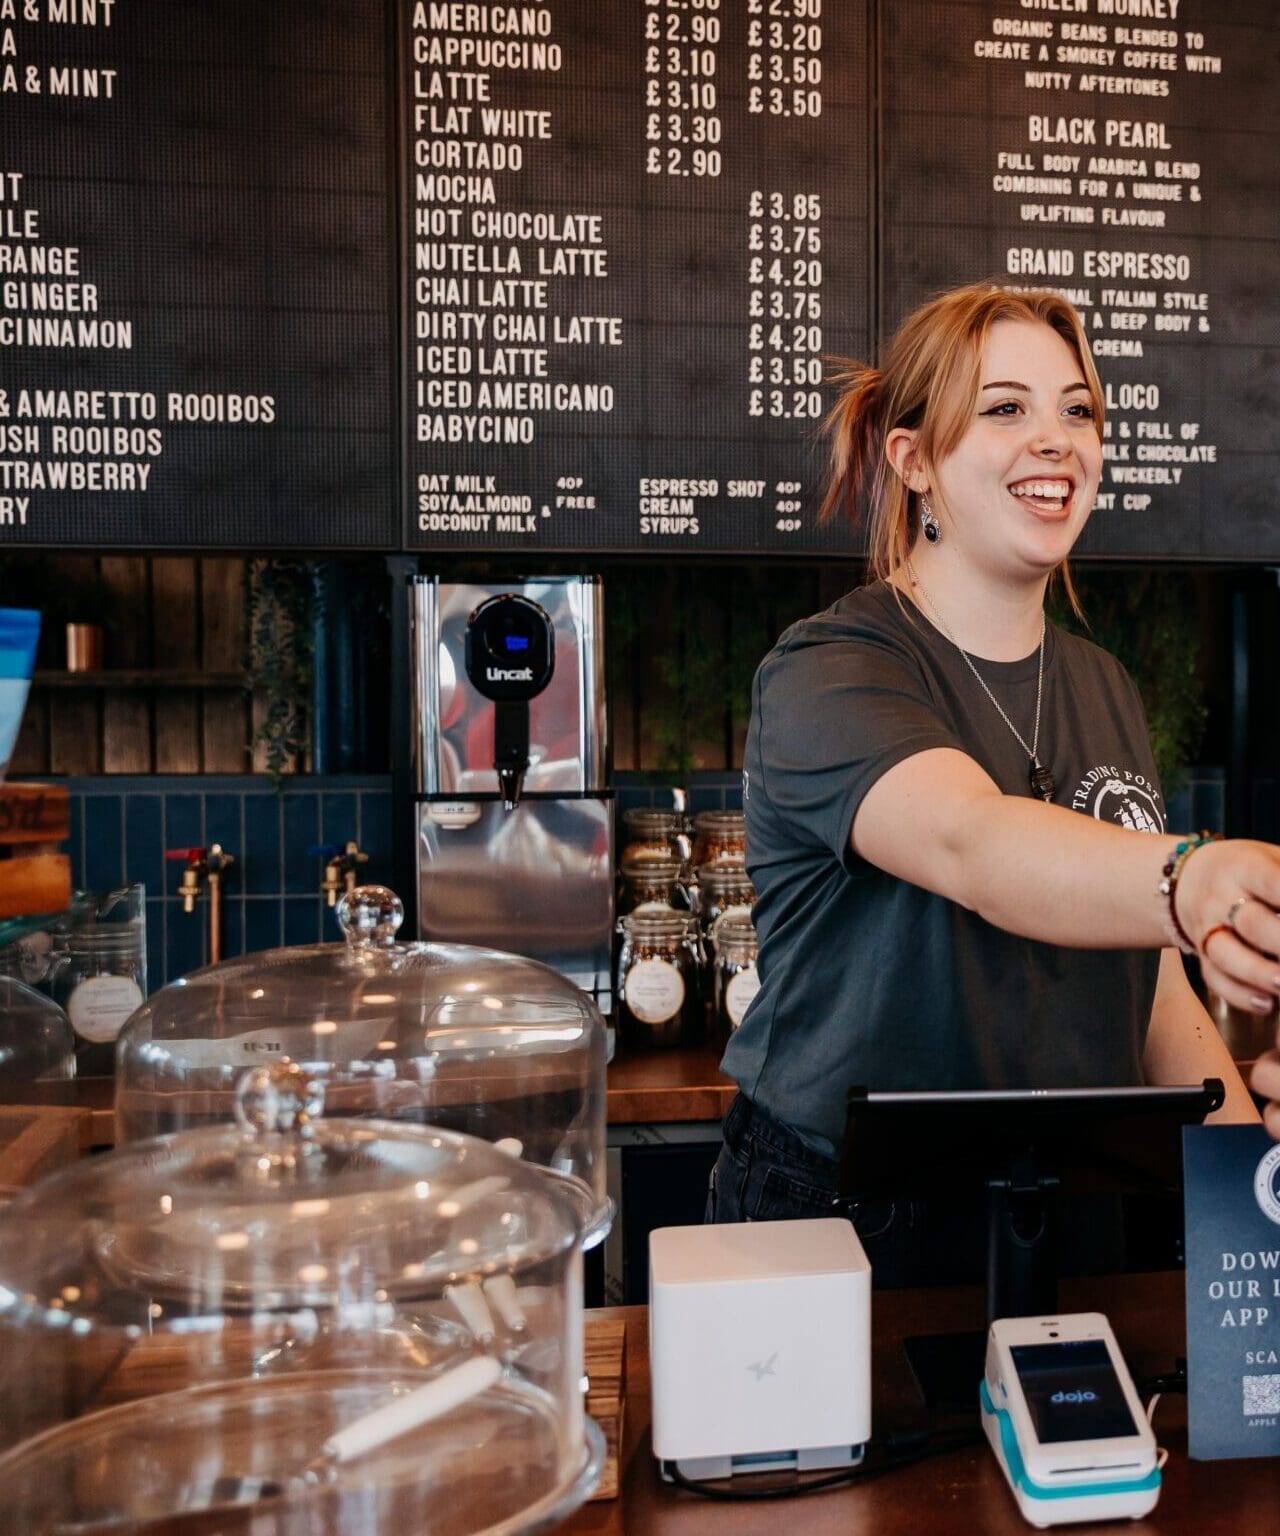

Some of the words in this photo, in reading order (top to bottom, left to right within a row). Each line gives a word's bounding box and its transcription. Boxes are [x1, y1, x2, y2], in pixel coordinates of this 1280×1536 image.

[23, 0, 40, 22] &
[48, 0, 115, 27] MINT
[412, 0, 552, 37] AMERICANO
[992, 18, 1054, 39] ORGANIC
[1060, 22, 1108, 43] BEANS
[1114, 26, 1178, 48] BLENDED
[1184, 31, 1204, 50] TO
[413, 35, 562, 72] CAPPUCCINO
[974, 40, 1030, 61] CREATE
[1038, 44, 1049, 62] A
[1056, 45, 1116, 66] SMOKEY
[1123, 50, 1178, 71] COFFEE
[1185, 55, 1222, 74] WITH
[24, 65, 41, 94] &
[49, 66, 117, 99] MINT
[414, 70, 491, 102] LATTE
[1024, 71, 1072, 90] NUTTY
[1078, 74, 1170, 97] AFTERTONES
[414, 104, 473, 135] FLAT
[480, 107, 553, 139] WHITE
[1028, 115, 1097, 145] BLACK
[1105, 119, 1172, 150] PEARL
[415, 139, 523, 172] CORTADO
[997, 151, 1035, 171] FULL
[1043, 154, 1081, 173] BODY
[1087, 156, 1148, 177] ARABICA
[1154, 160, 1201, 180] BLEND
[416, 173, 496, 205] MOCHA
[992, 174, 1072, 195] COMBINING
[1079, 178, 1108, 198] FOR
[1114, 181, 1126, 199] A
[1132, 182, 1182, 202] UNIQUE
[1189, 185, 1202, 202] &
[415, 207, 463, 237] HOT
[471, 210, 603, 244] CHOCOLATE
[1020, 204, 1095, 224] UPLIFTING
[1101, 207, 1166, 228] FLAVOUR
[415, 242, 522, 274] NUTELLA
[538, 247, 608, 277] LATTE
[1006, 247, 1074, 276] GRAND
[1083, 250, 1190, 281] ESPRESSO
[3, 281, 98, 313] GINGER
[415, 276, 470, 306] CHAI
[477, 278, 548, 309] LATTE
[1101, 289, 1157, 308] ITALIAN
[1163, 291, 1209, 311] STYLE
[0, 316, 132, 349] CINNAMON
[416, 310, 487, 341] DIRTY
[492, 313, 546, 343] CHAI
[553, 315, 623, 346] LATTE
[1092, 311, 1104, 329] A
[1110, 312, 1148, 331] DEEP
[1154, 313, 1192, 332] BODY
[1198, 315, 1211, 333] &
[416, 345, 472, 375] ICED
[478, 347, 548, 377] LATTE
[1092, 339, 1144, 358] CREMA
[16, 389, 156, 421] AMARETTO
[167, 392, 275, 423] ROOIBOS
[417, 379, 472, 409] ICED
[477, 381, 614, 412] AMERICANO
[1105, 383, 1160, 411] LOCO
[52, 425, 163, 456] ROOIBOS
[417, 413, 534, 444] BABYCINO
[1118, 421, 1131, 439] &
[1136, 421, 1174, 440] FULL
[1180, 422, 1200, 440] OF
[1136, 444, 1217, 463] CHOCOLATE
[418, 473, 450, 493] OAT
[454, 474, 496, 493] MILK
[639, 478, 719, 497] ESPRESSO
[726, 479, 767, 498] SHOT
[1110, 466, 1183, 485] WICKEDLY
[541, 505, 552, 518] &
[555, 495, 596, 510] FREE
[639, 497, 694, 516] CREAM
[1122, 493, 1152, 511] CUP
[418, 513, 491, 532] COCONUT
[495, 514, 537, 533] MILK
[639, 516, 700, 535] SYRUPS
[1072, 766, 1120, 810] TRADING
[1123, 770, 1160, 802] POST
[1208, 1279, 1261, 1300] OUR
[1220, 1307, 1269, 1328] APP
[1050, 1389, 1097, 1404] dojo
[1247, 1417, 1276, 1427] APPLE
